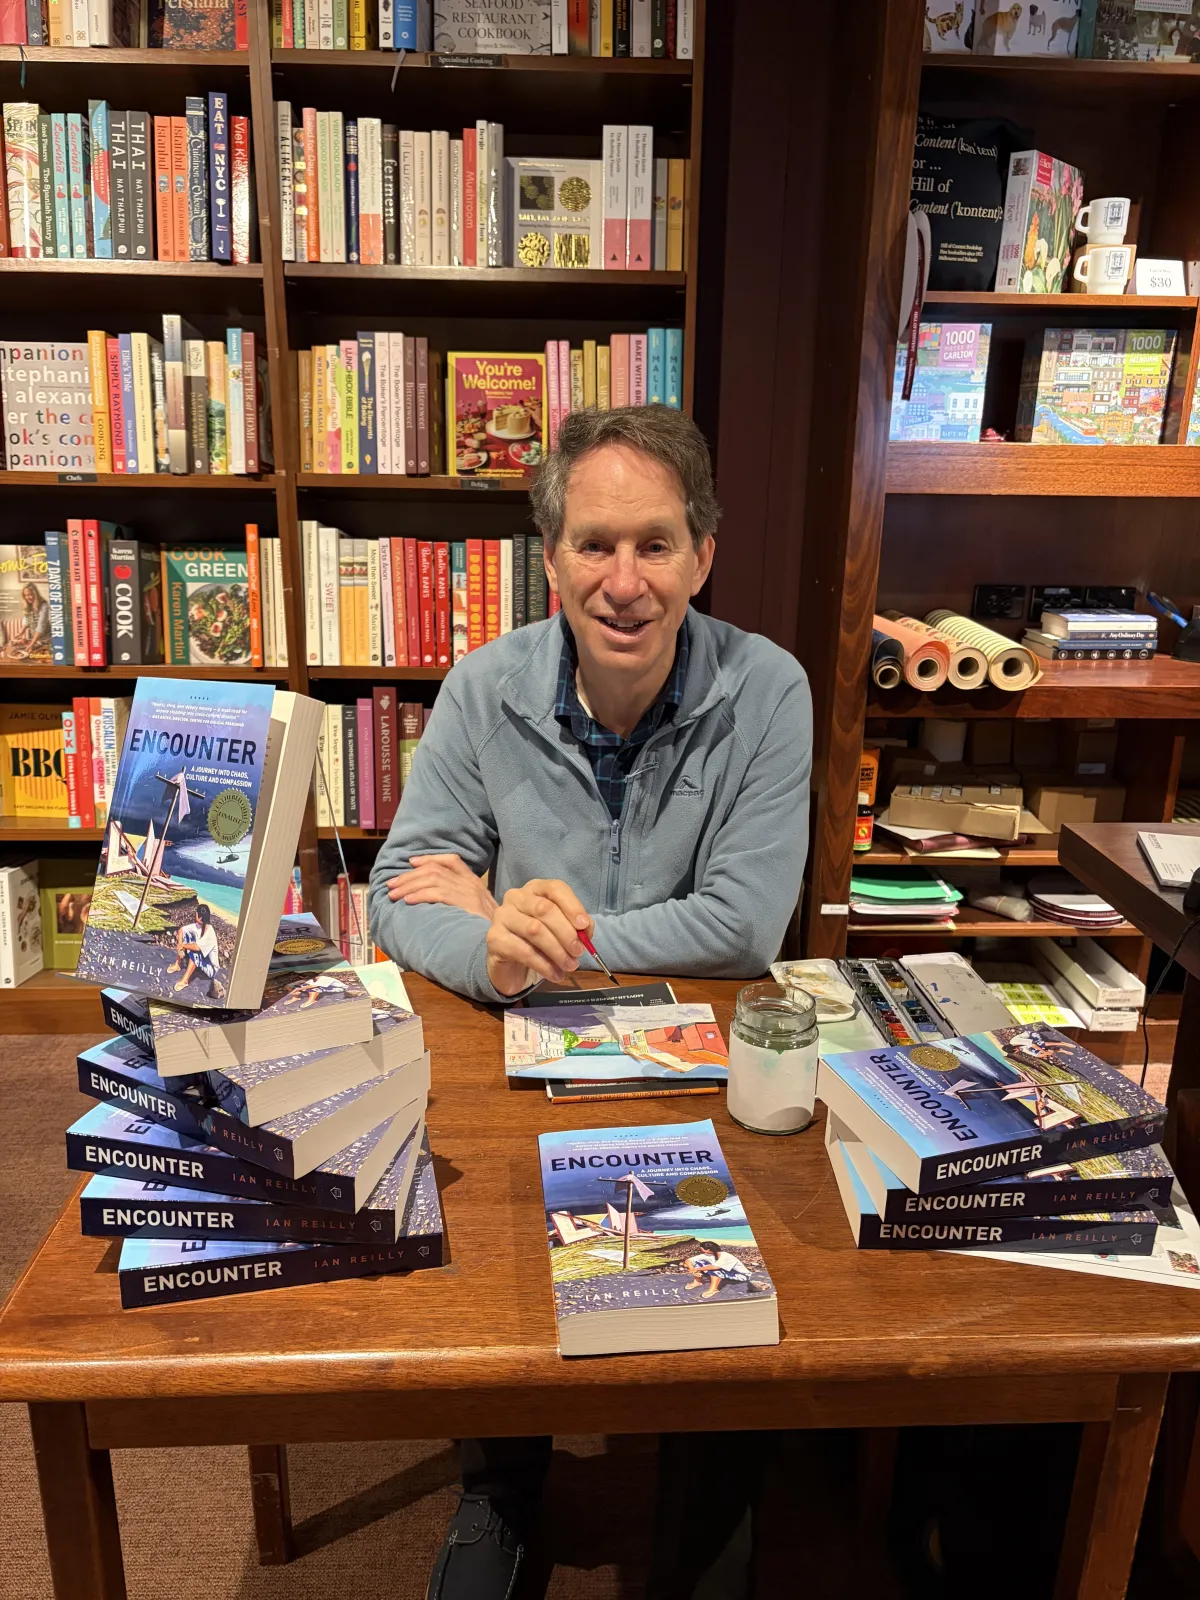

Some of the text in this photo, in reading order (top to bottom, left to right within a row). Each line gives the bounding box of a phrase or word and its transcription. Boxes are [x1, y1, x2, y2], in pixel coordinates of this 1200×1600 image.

[452, 12, 537, 25] RESTAURANT
[457, 27, 532, 40] COOKBOOK
[438, 57, 468, 65] Specialised
[214, 97, 226, 191] EAT NYC
[915, 134, 957, 149] Content
[111, 121, 126, 234] THAI NAT THAIPUN
[131, 122, 145, 234] THAI NAT THAIPUN
[911, 177, 953, 193] Hill of
[43, 183, 51, 215] Spanish
[384, 159, 397, 225] ferment
[465, 171, 475, 229] Mushroom
[910, 199, 949, 214] Content
[44, 216, 53, 241] Pantry
[1150, 277, 1172, 288] $30
[946, 330, 975, 345] 1000
[1132, 335, 1161, 350] 1000
[943, 351, 973, 360] CARLTON
[476, 361, 523, 377] You're
[462, 374, 536, 390] Welcome!
[110, 355, 122, 446] SIMPLY RAYMOND
[245, 402, 254, 412] at
[406, 382, 414, 429] Bittersweet
[419, 383, 427, 430] Bittersweet
[9, 429, 50, 445] ok's
[246, 413, 255, 442] HOME
[98, 419, 106, 460] COOKING
[10, 451, 82, 469] panion
[47, 560, 59, 568] 7
[111, 553, 136, 561] Martini
[170, 547, 227, 561] COOK
[48, 568, 61, 591] DAYS
[184, 562, 248, 578] GREEN
[514, 538, 525, 611] LOVE CRUMBS
[49, 592, 62, 603] OF
[324, 583, 334, 613] SWEET
[469, 555, 481, 645] DOBRI DOBRI
[50, 605, 64, 637] DINNER
[115, 584, 133, 639] COOK
[172, 581, 186, 660] Karen Martini
[371, 614, 379, 631] Marie
[64, 719, 73, 748] OTK
[102, 707, 115, 750] JERUSALEM
[78, 708, 88, 787] OTTOLENGHI
[129, 728, 257, 766] ENCOUNTER
[94, 719, 106, 800] Ottolenghi COMFORT
[380, 716, 391, 802] LAROUSSE WINE
[185, 774, 207, 782] CULTURE
[220, 777, 252, 788] COMPASSION
[196, 767, 217, 775] JOURNEY
[218, 769, 230, 777] INTO
[231, 771, 249, 779] CHAOS,
[219, 812, 242, 824] FINALIST
[97, 954, 163, 977] IAN REILLY
[90, 1072, 177, 1120] ENCOUNTER
[870, 1053, 978, 1142] ENCOUNTER
[1066, 1128, 1136, 1151] IAN REILLY
[85, 1145, 205, 1179] ENCOUNTER
[551, 1150, 715, 1172] ENCOUNTER
[935, 1144, 1043, 1181] ENCOUNTER
[232, 1172, 317, 1195] IAN REILLY
[905, 1191, 1026, 1213] ENCOUNTER
[1053, 1190, 1137, 1202] IAN REILLY
[102, 1207, 235, 1229] ENCOUNTER
[265, 1218, 357, 1229] IAN REILLY
[879, 1223, 1003, 1242] ENCOUNTER
[1031, 1232, 1119, 1243] IAN REILLY
[314, 1249, 405, 1269] IAN REILLY
[143, 1261, 283, 1294] ENCOUNTER
[585, 1287, 680, 1301] IAN REILLY
